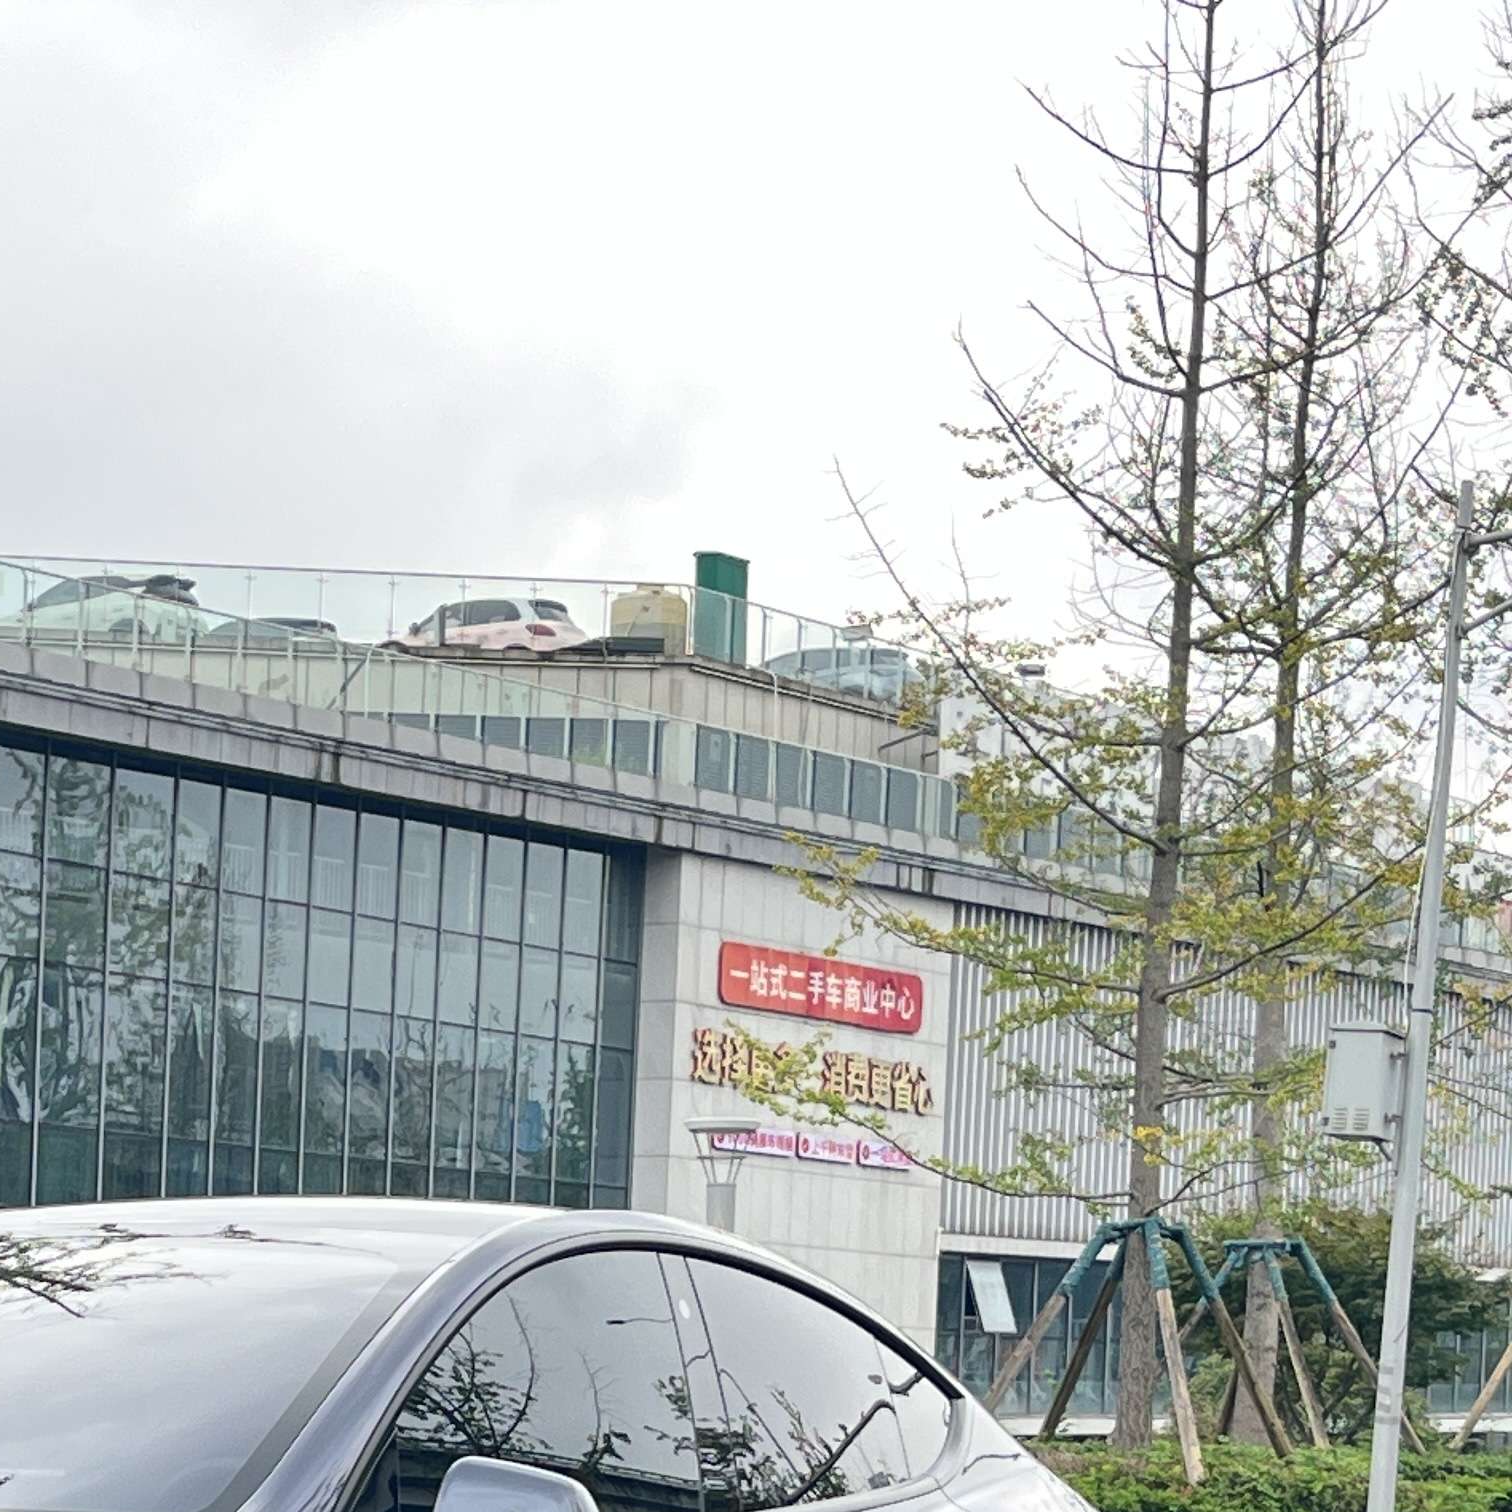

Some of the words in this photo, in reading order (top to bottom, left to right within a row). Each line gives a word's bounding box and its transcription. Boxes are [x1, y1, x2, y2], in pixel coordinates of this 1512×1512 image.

[729, 959, 915, 1020] 一站式二手车商业中心
